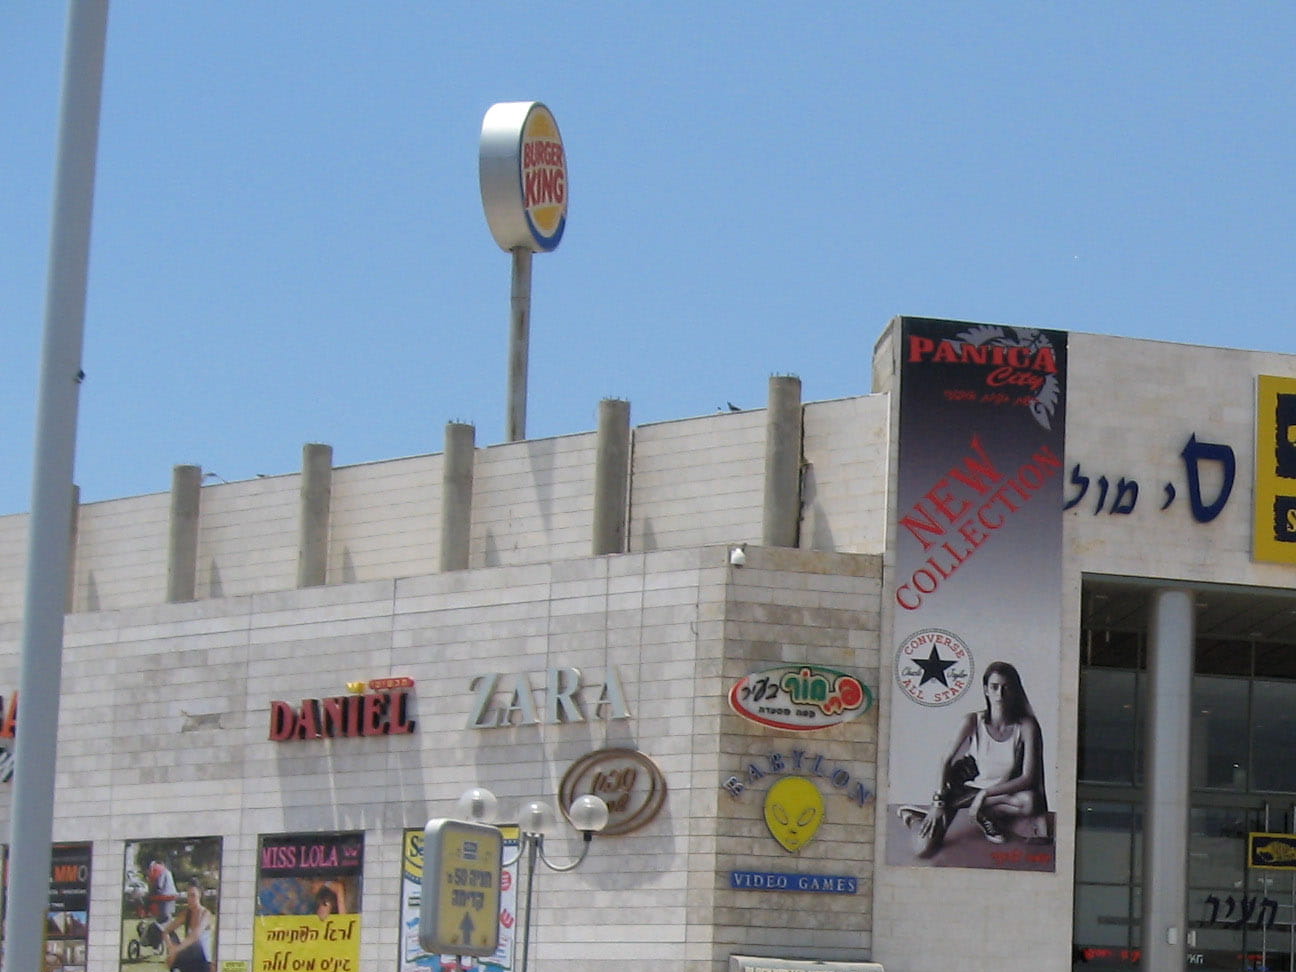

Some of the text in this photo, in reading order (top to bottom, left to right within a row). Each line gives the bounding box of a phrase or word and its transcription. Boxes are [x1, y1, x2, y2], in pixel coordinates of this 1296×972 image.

[523, 140, 564, 169] BURGER
[524, 167, 564, 208] KING
[907, 335, 1058, 374] PANICA
[985, 366, 1045, 391] City
[898, 434, 1006, 551] NEW
[1062, 463, 1139, 516] מול
[1161, 432, 1236, 524] סי
[896, 445, 1063, 611] COLLECTION
[904, 633, 965, 659] CONVERSE
[466, 664, 631, 730] ZARA
[903, 679, 965, 702] ALL STAR
[268, 692, 415, 741] DANIEL
[723, 750, 872, 808] BABYLON
[261, 844, 338, 869] MISS LOLA
[733, 873, 855, 892] VIDEO GAMES
[1204, 894, 1278, 930] העיר
[263, 951, 292, 971] לולה
[292, 958, 316, 971] מיס
